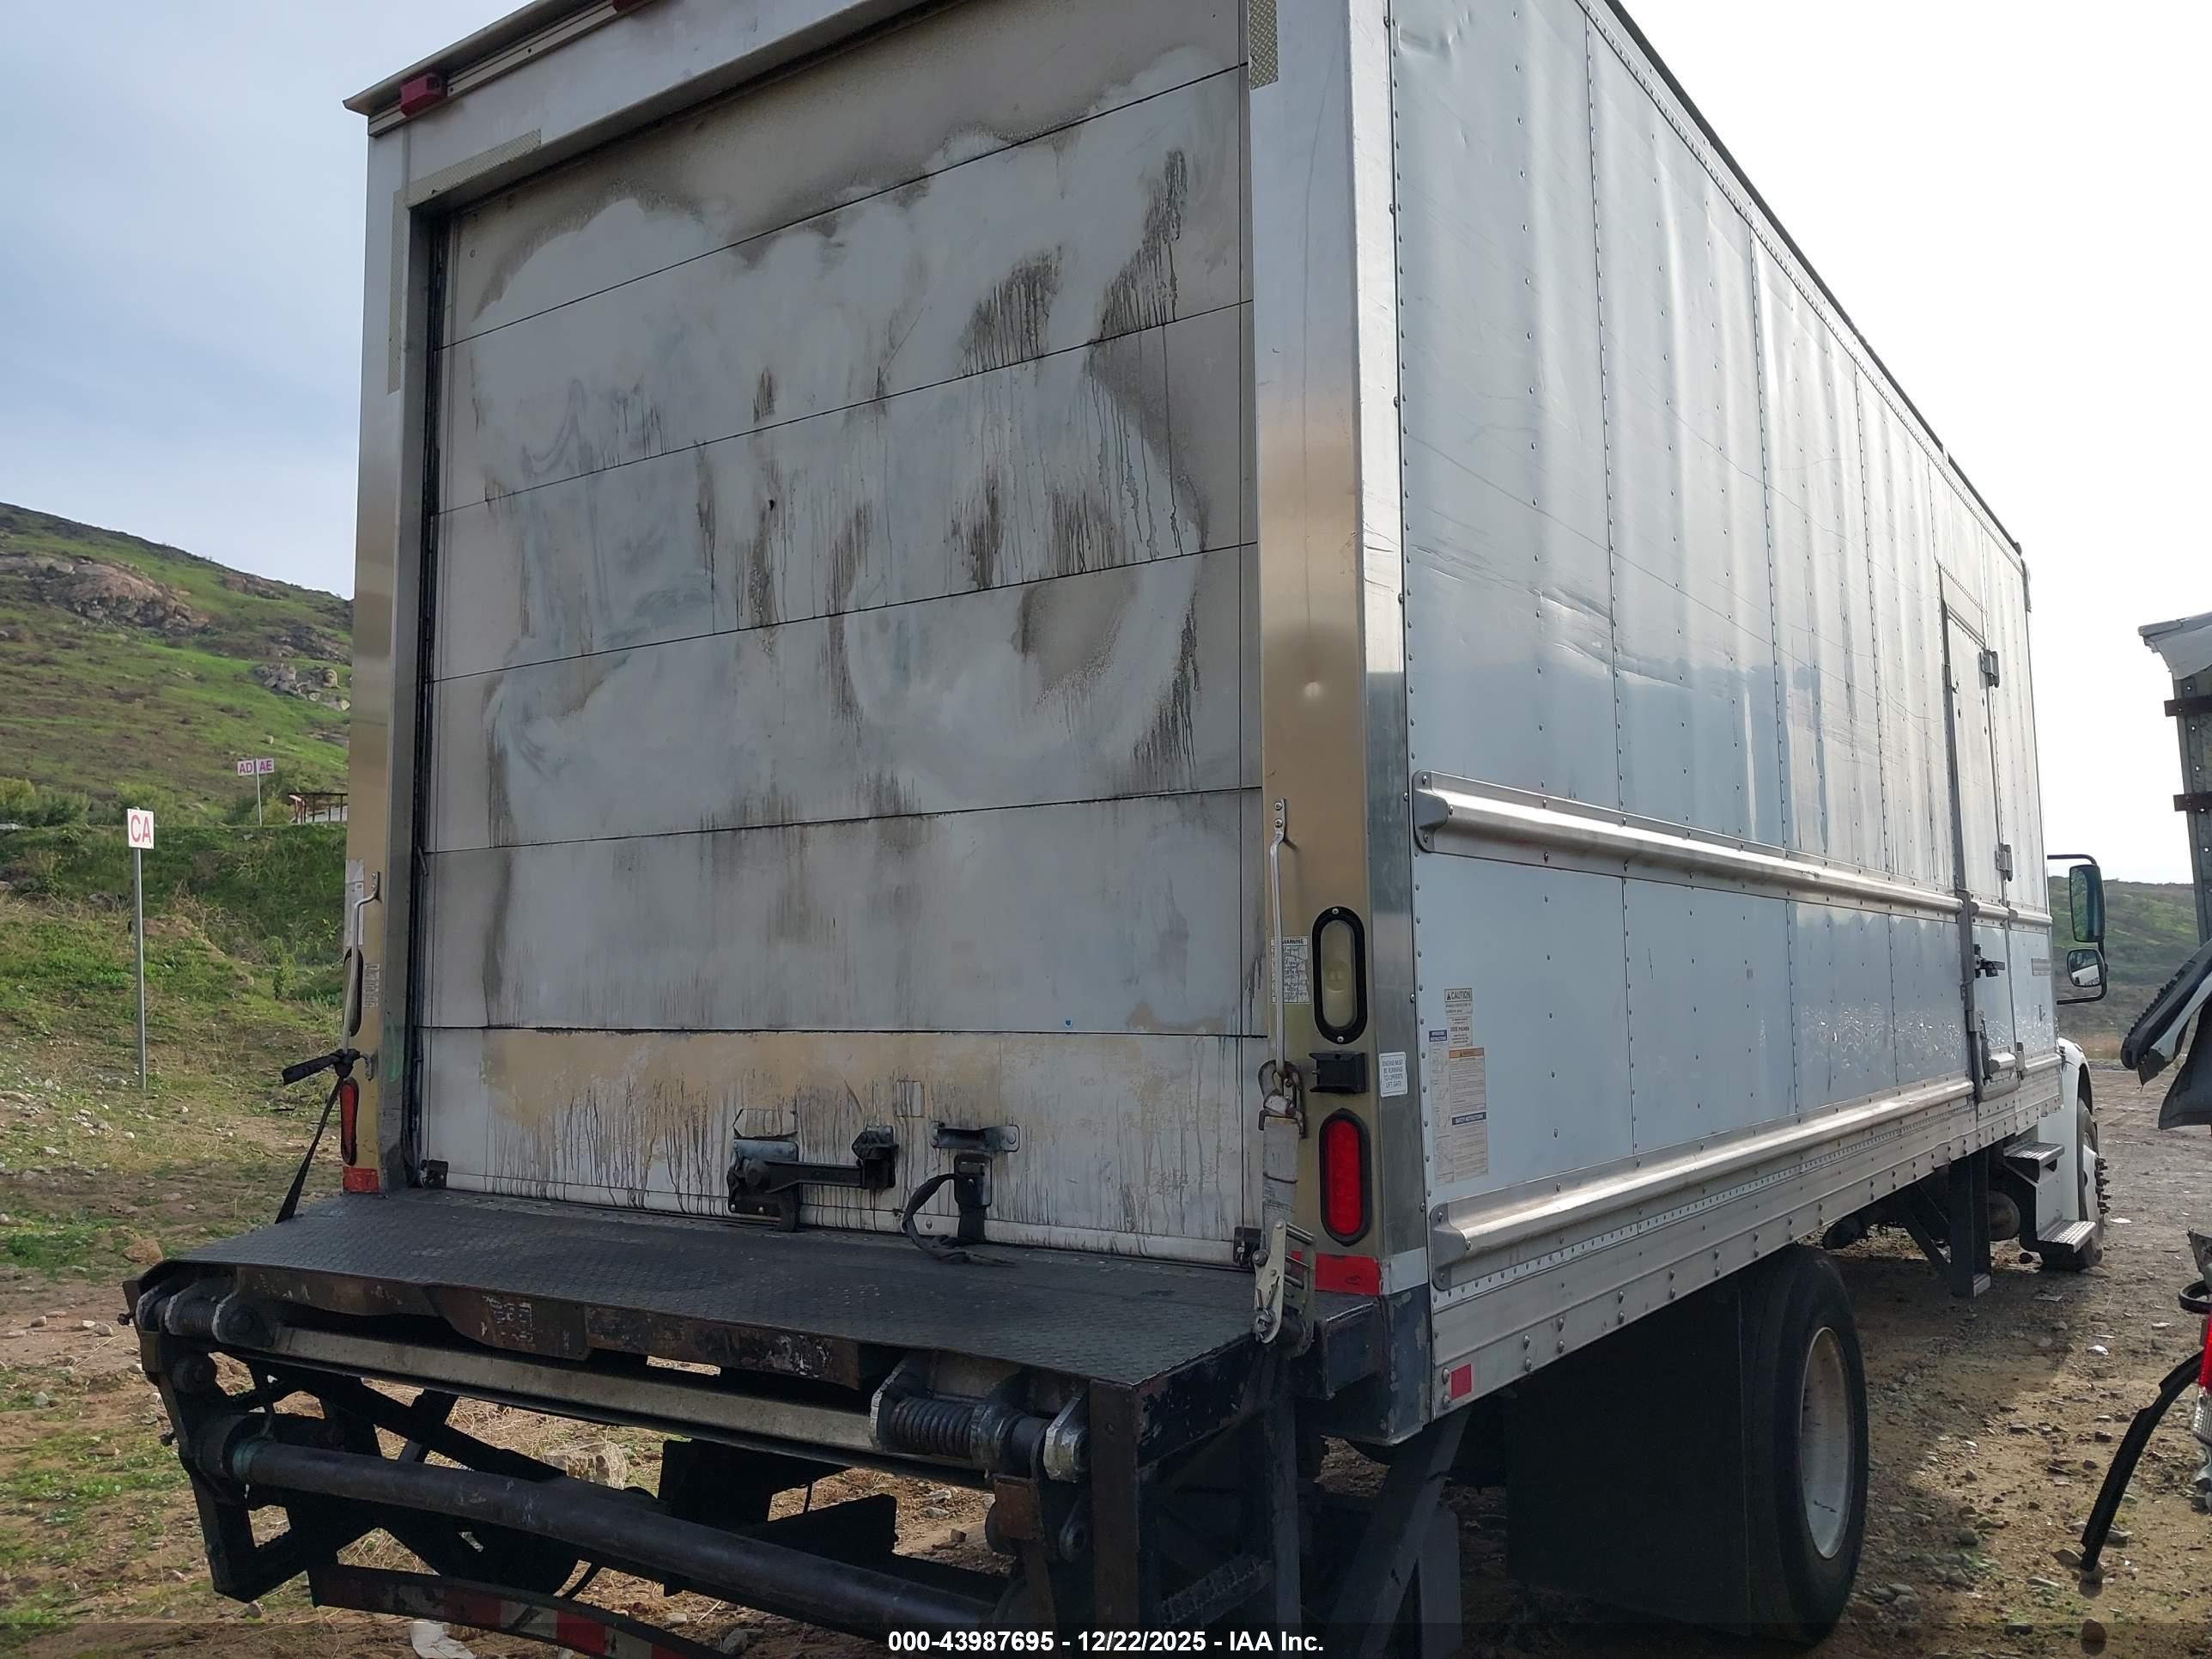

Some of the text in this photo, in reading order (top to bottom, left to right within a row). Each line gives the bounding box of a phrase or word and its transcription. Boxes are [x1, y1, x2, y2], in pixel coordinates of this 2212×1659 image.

[240, 763, 253, 774] AD
[260, 761, 272, 771] AE
[131, 815, 152, 843] CA
[1451, 991, 1471, 1000] CAUTION
